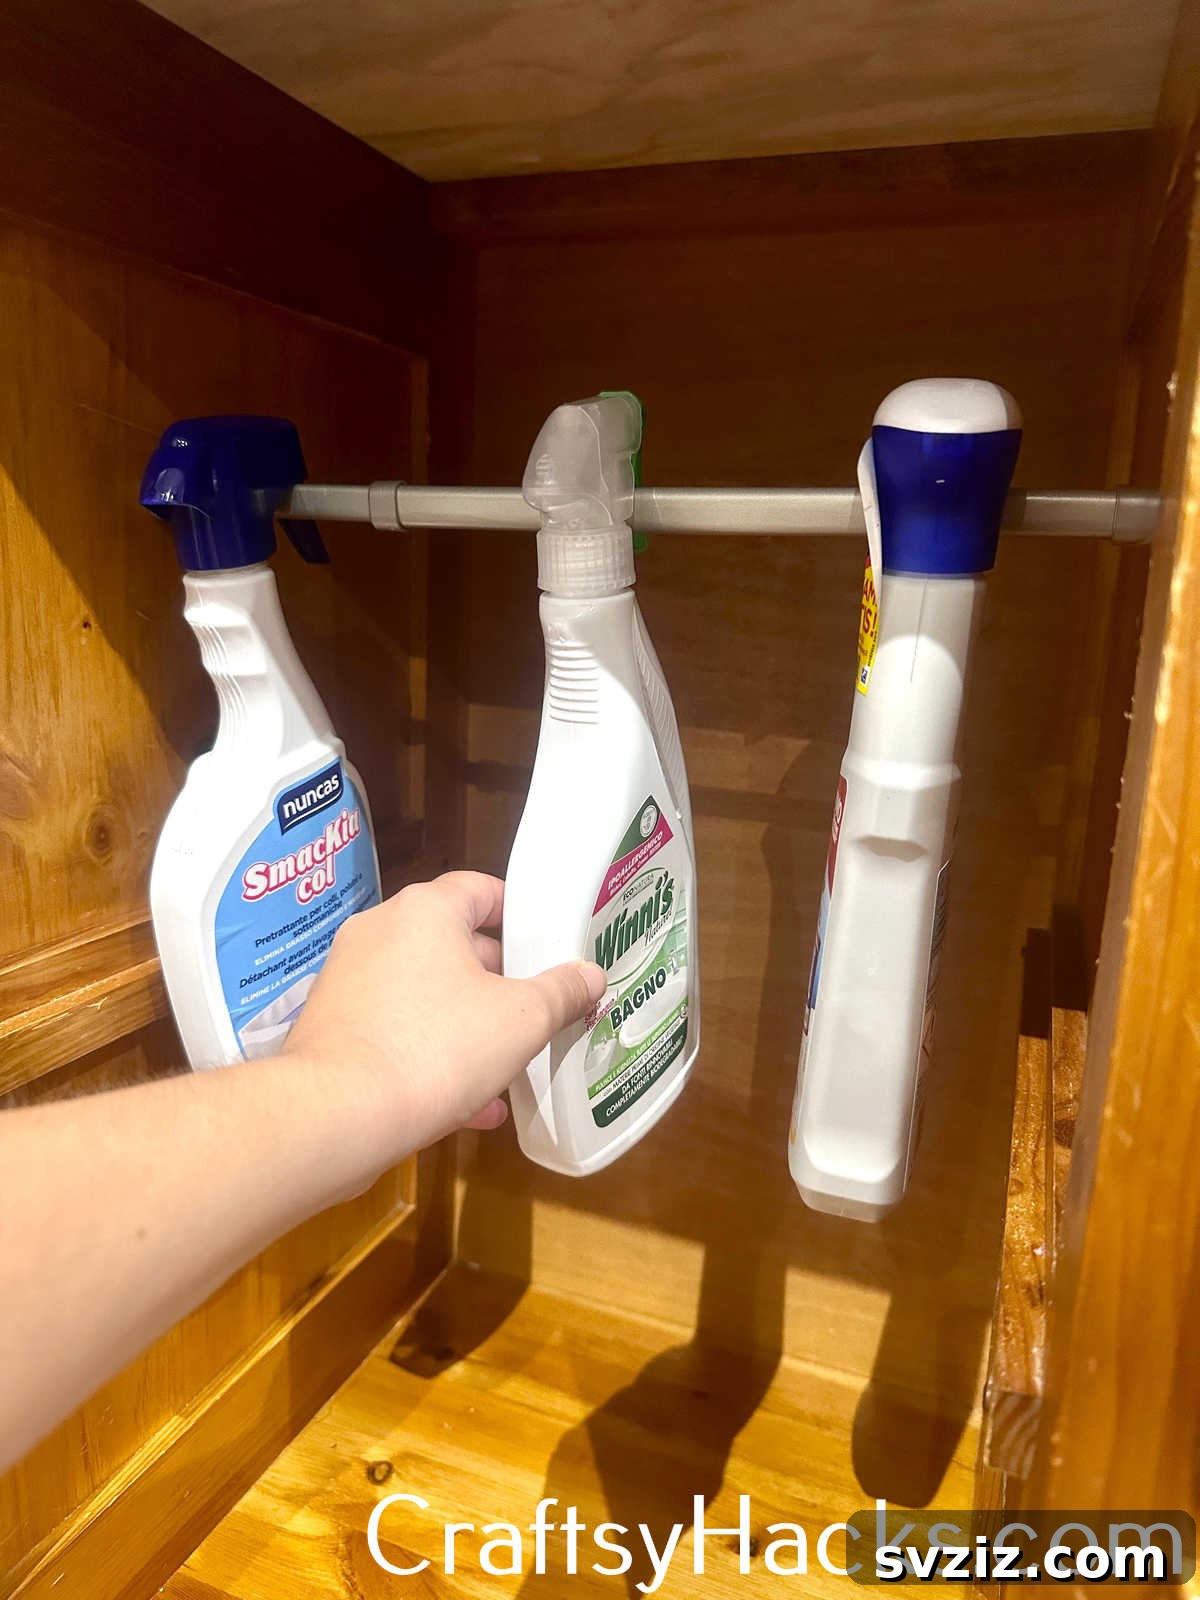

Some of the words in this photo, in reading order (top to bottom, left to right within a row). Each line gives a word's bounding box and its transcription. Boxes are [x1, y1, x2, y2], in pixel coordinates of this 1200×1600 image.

[282, 773, 340, 819] nuncas
[297, 854, 336, 903] col
[608, 831, 663, 891] IPOALLERGENICO
[255, 914, 309, 948] Pretrattante
[309, 905, 322, 919] per
[293, 900, 343, 938] sottomaniche
[594, 870, 674, 972] Winni's
[239, 958, 287, 989] Détachant
[288, 942, 312, 963] avant
[254, 946, 285, 967] ELIMINA
[284, 952, 317, 976] dessous
[318, 942, 328, 954] de
[610, 968, 667, 1030] BAGNO
[606, 1074, 650, 1117] COMPLETAMENTE
[621, 1083, 631, 1095] DA
[630, 1065, 647, 1086] FONTI
